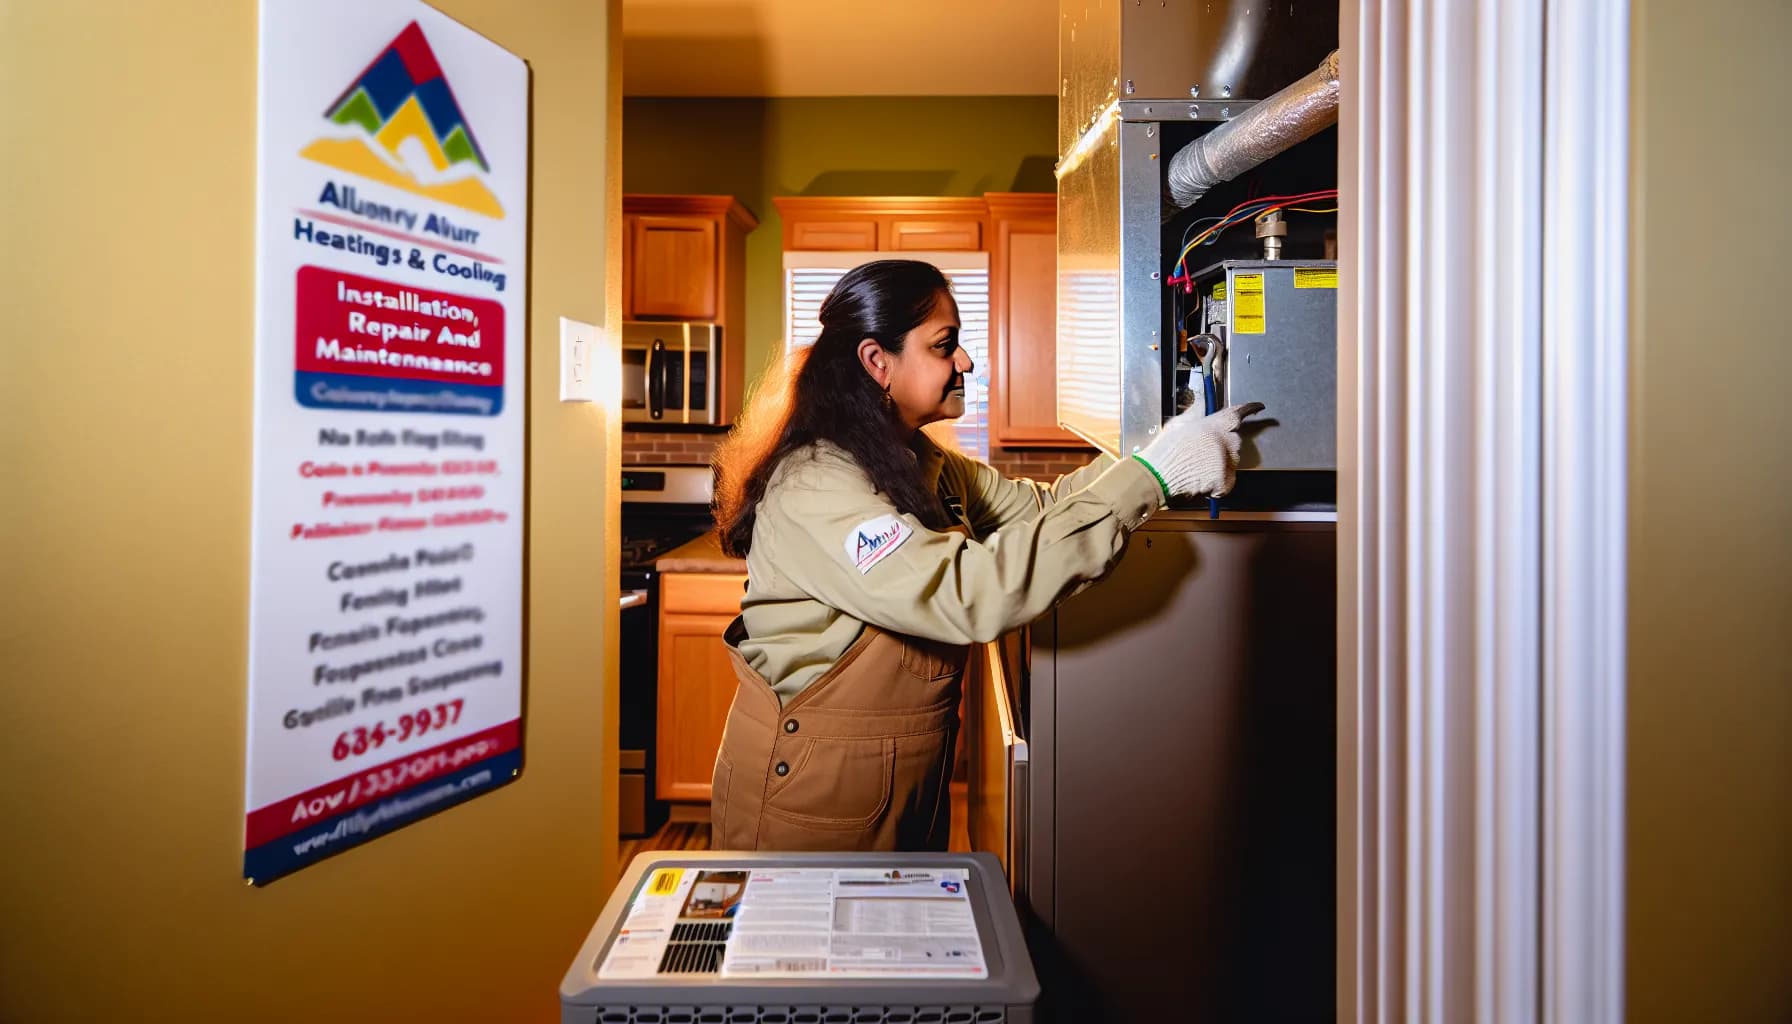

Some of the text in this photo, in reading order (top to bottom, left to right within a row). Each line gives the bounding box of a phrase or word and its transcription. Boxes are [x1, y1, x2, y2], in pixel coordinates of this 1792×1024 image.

[294, 218, 402, 266] Heatings
[408, 249, 425, 270] &
[349, 312, 481, 348] Repair And
